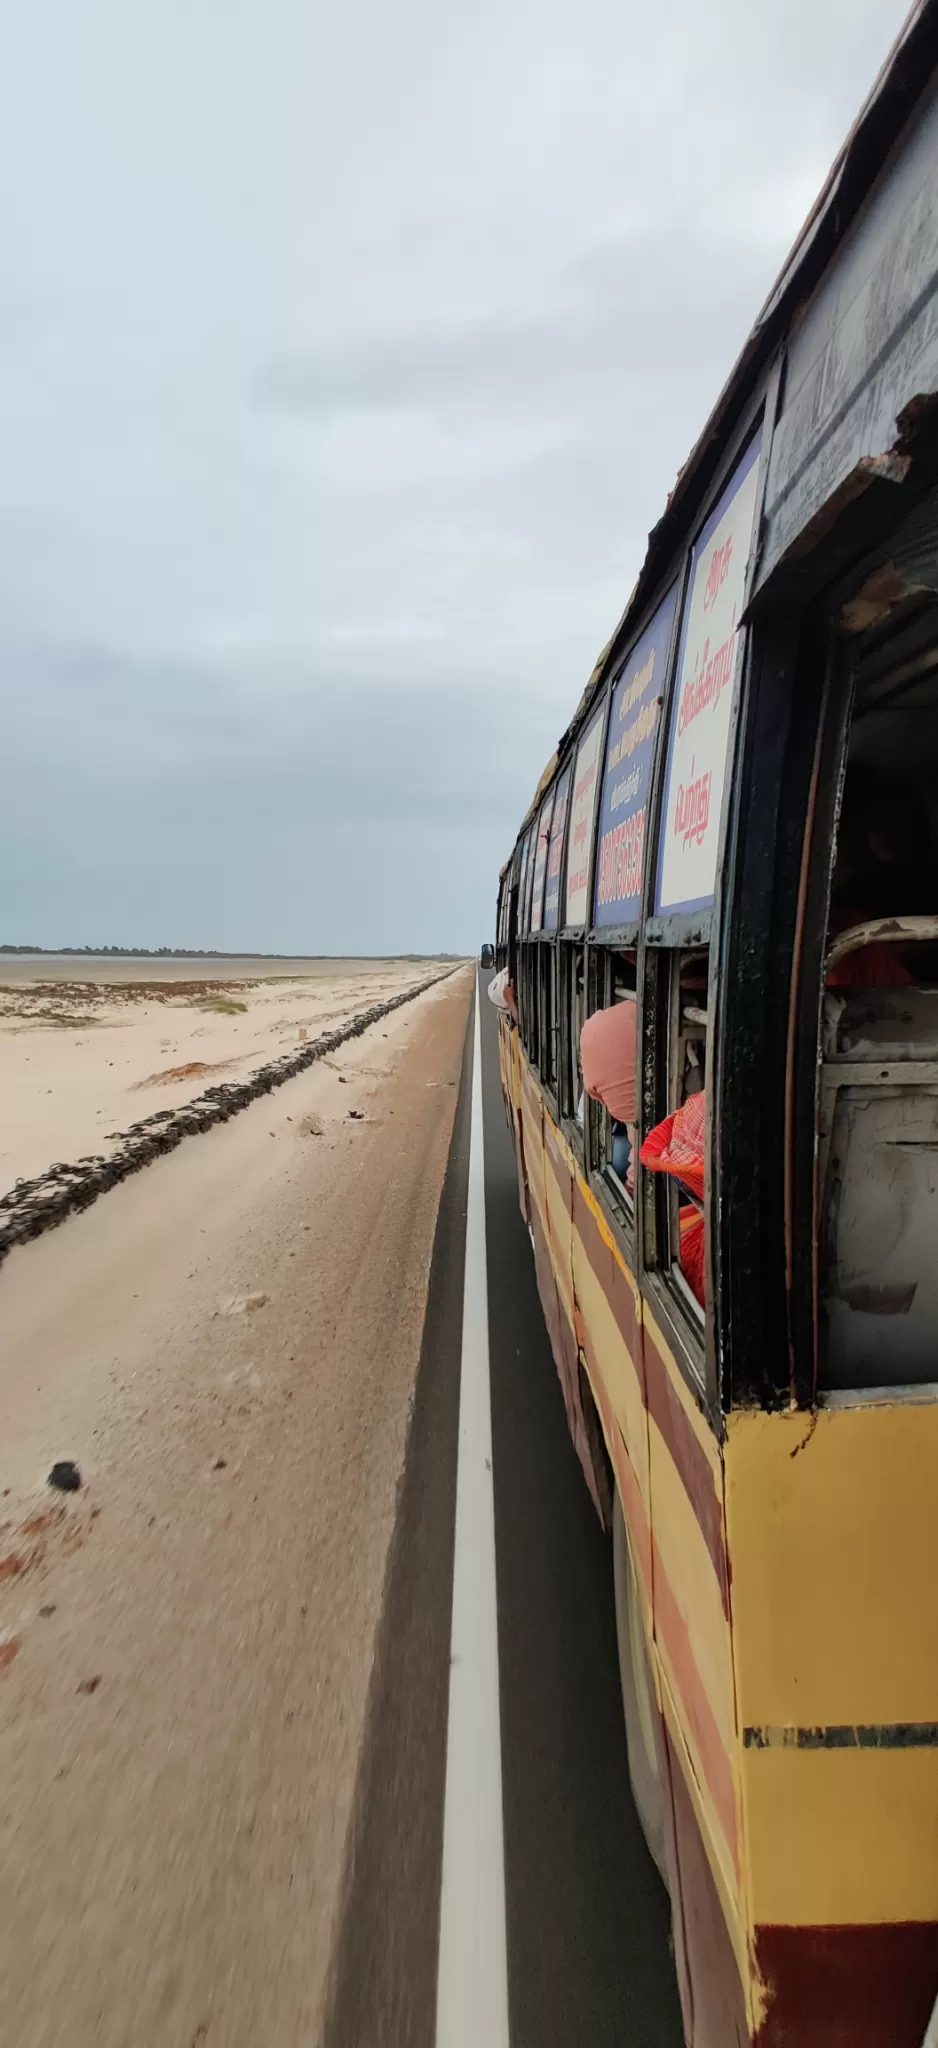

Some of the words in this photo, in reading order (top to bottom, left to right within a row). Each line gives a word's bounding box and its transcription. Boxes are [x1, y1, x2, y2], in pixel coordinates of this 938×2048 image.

[704, 534, 732, 610] அரசு
[678, 603, 736, 739] அங்கீகாரம்
[674, 755, 712, 851] பெற்றது
